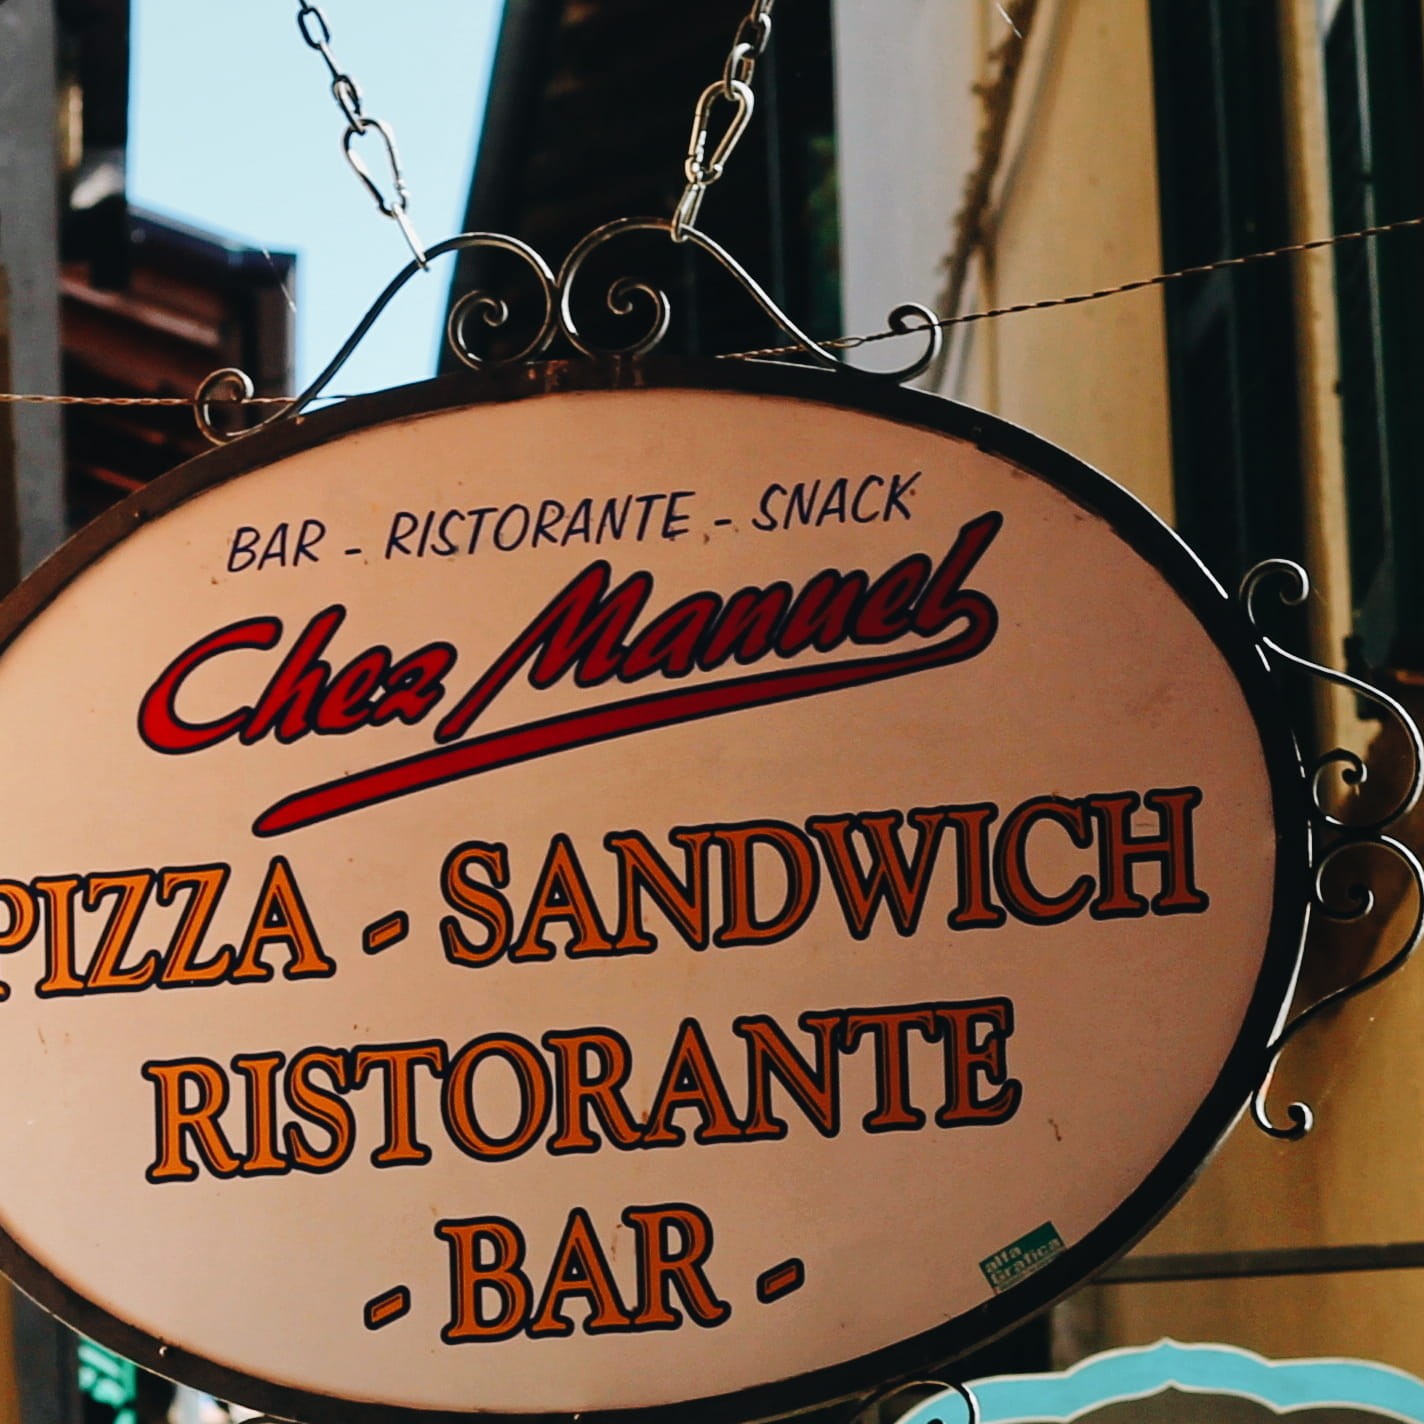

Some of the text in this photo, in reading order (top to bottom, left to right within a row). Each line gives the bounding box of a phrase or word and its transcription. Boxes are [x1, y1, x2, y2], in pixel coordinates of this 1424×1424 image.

[226, 519, 326, 573] BAR
[384, 491, 697, 562] RISTORANTE
[751, 471, 922, 531] SNACK
[137, 510, 1004, 755] Chez Manuel
[439, 786, 1210, 969] SANDWICH
[143, 997, 1023, 1184] RISTORANTE
[436, 1203, 731, 1345] BAR
